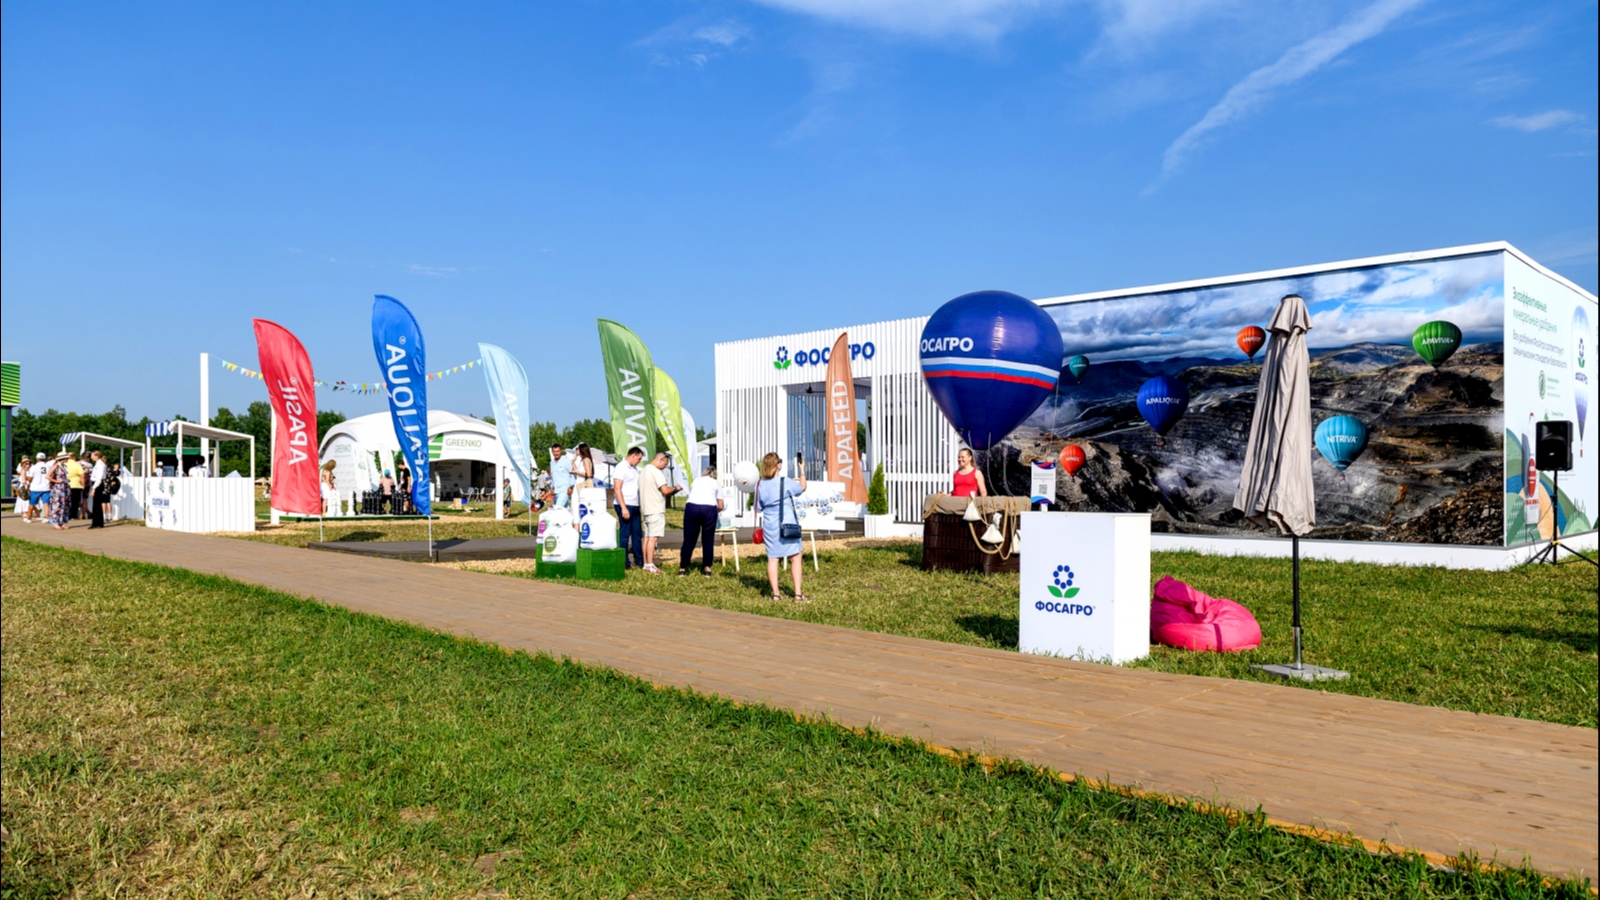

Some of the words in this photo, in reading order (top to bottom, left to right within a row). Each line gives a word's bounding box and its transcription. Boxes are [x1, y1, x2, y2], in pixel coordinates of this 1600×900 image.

[794, 341, 875, 367] ФОСРО
[1145, 397, 1181, 405] APALIQUA
[831, 380, 853, 479] APAFEED
[446, 438, 482, 448] GREENKO
[1326, 435, 1356, 444] NITRIVA
[41, 466, 47, 475] 3
[1034, 600, 1093, 616] ФОСАГРО
